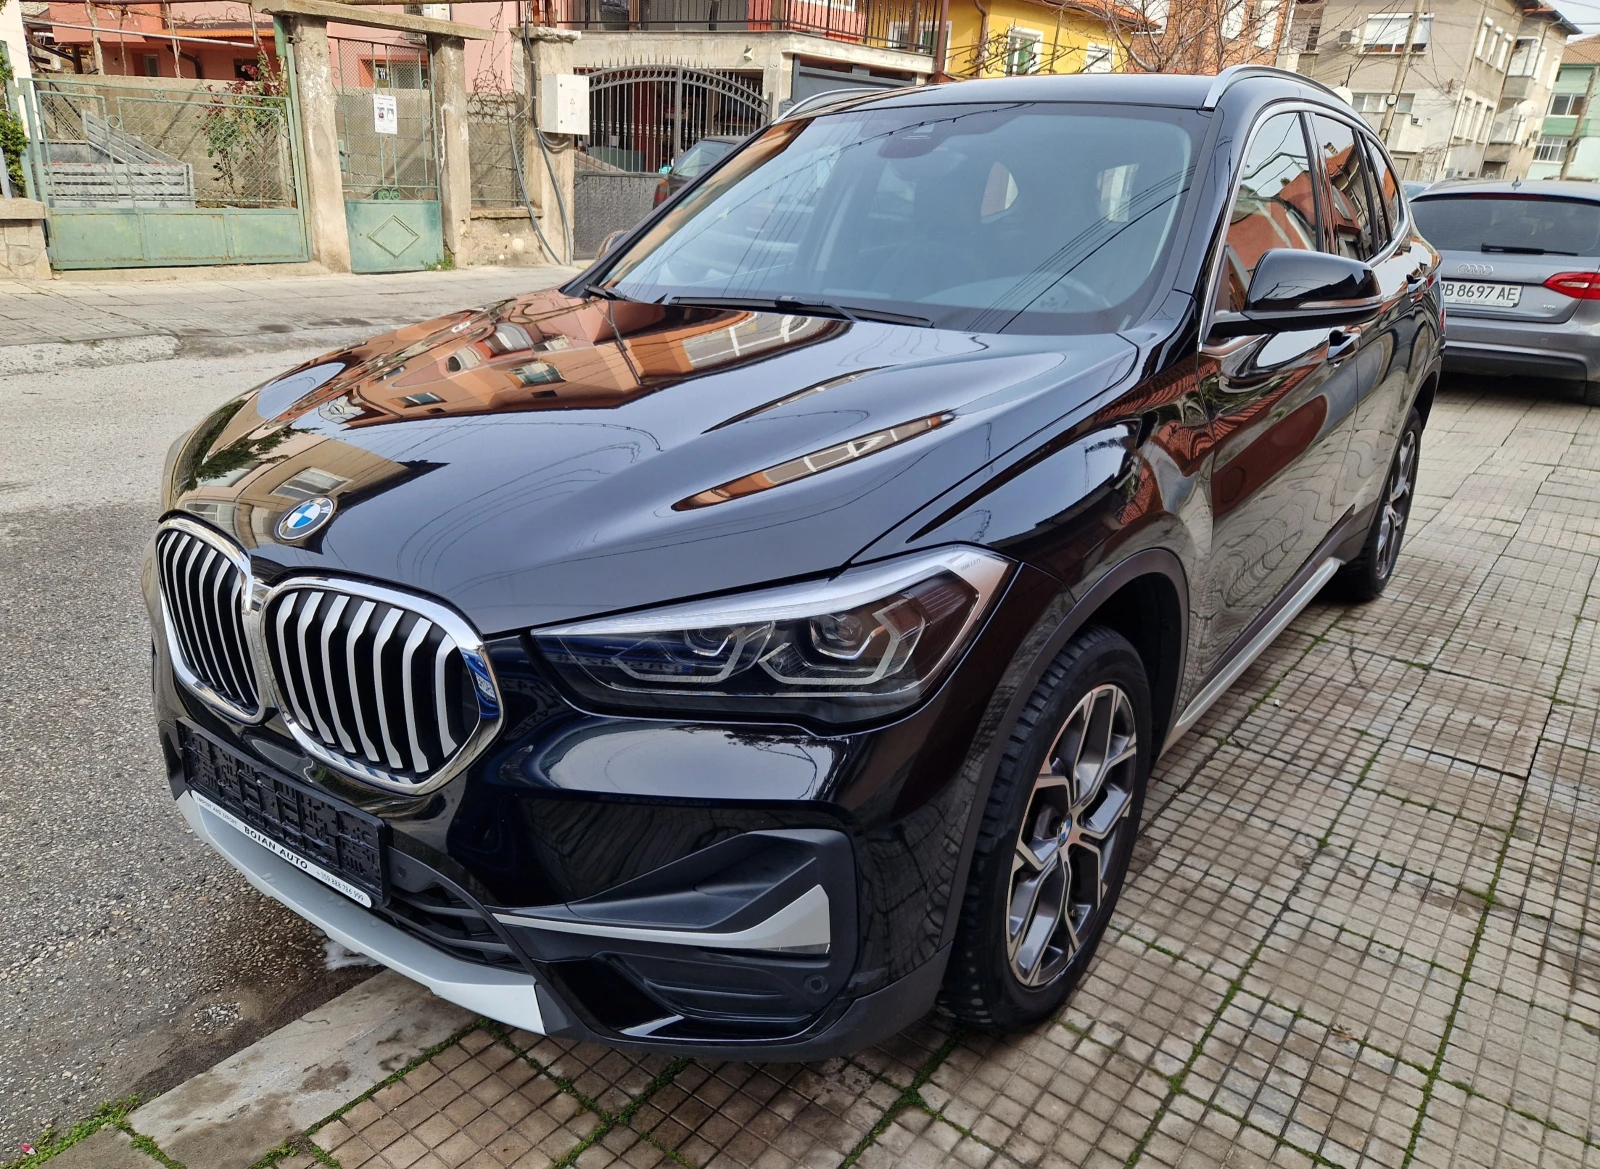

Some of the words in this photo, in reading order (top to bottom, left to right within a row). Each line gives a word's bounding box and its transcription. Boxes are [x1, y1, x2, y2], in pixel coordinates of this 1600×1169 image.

[1457, 284, 1496, 299] 8697
[1496, 287, 1518, 301] AE
[212, 807, 222, 816] AND
[244, 826, 276, 851] BOIAN
[280, 848, 308, 869] AUTO
